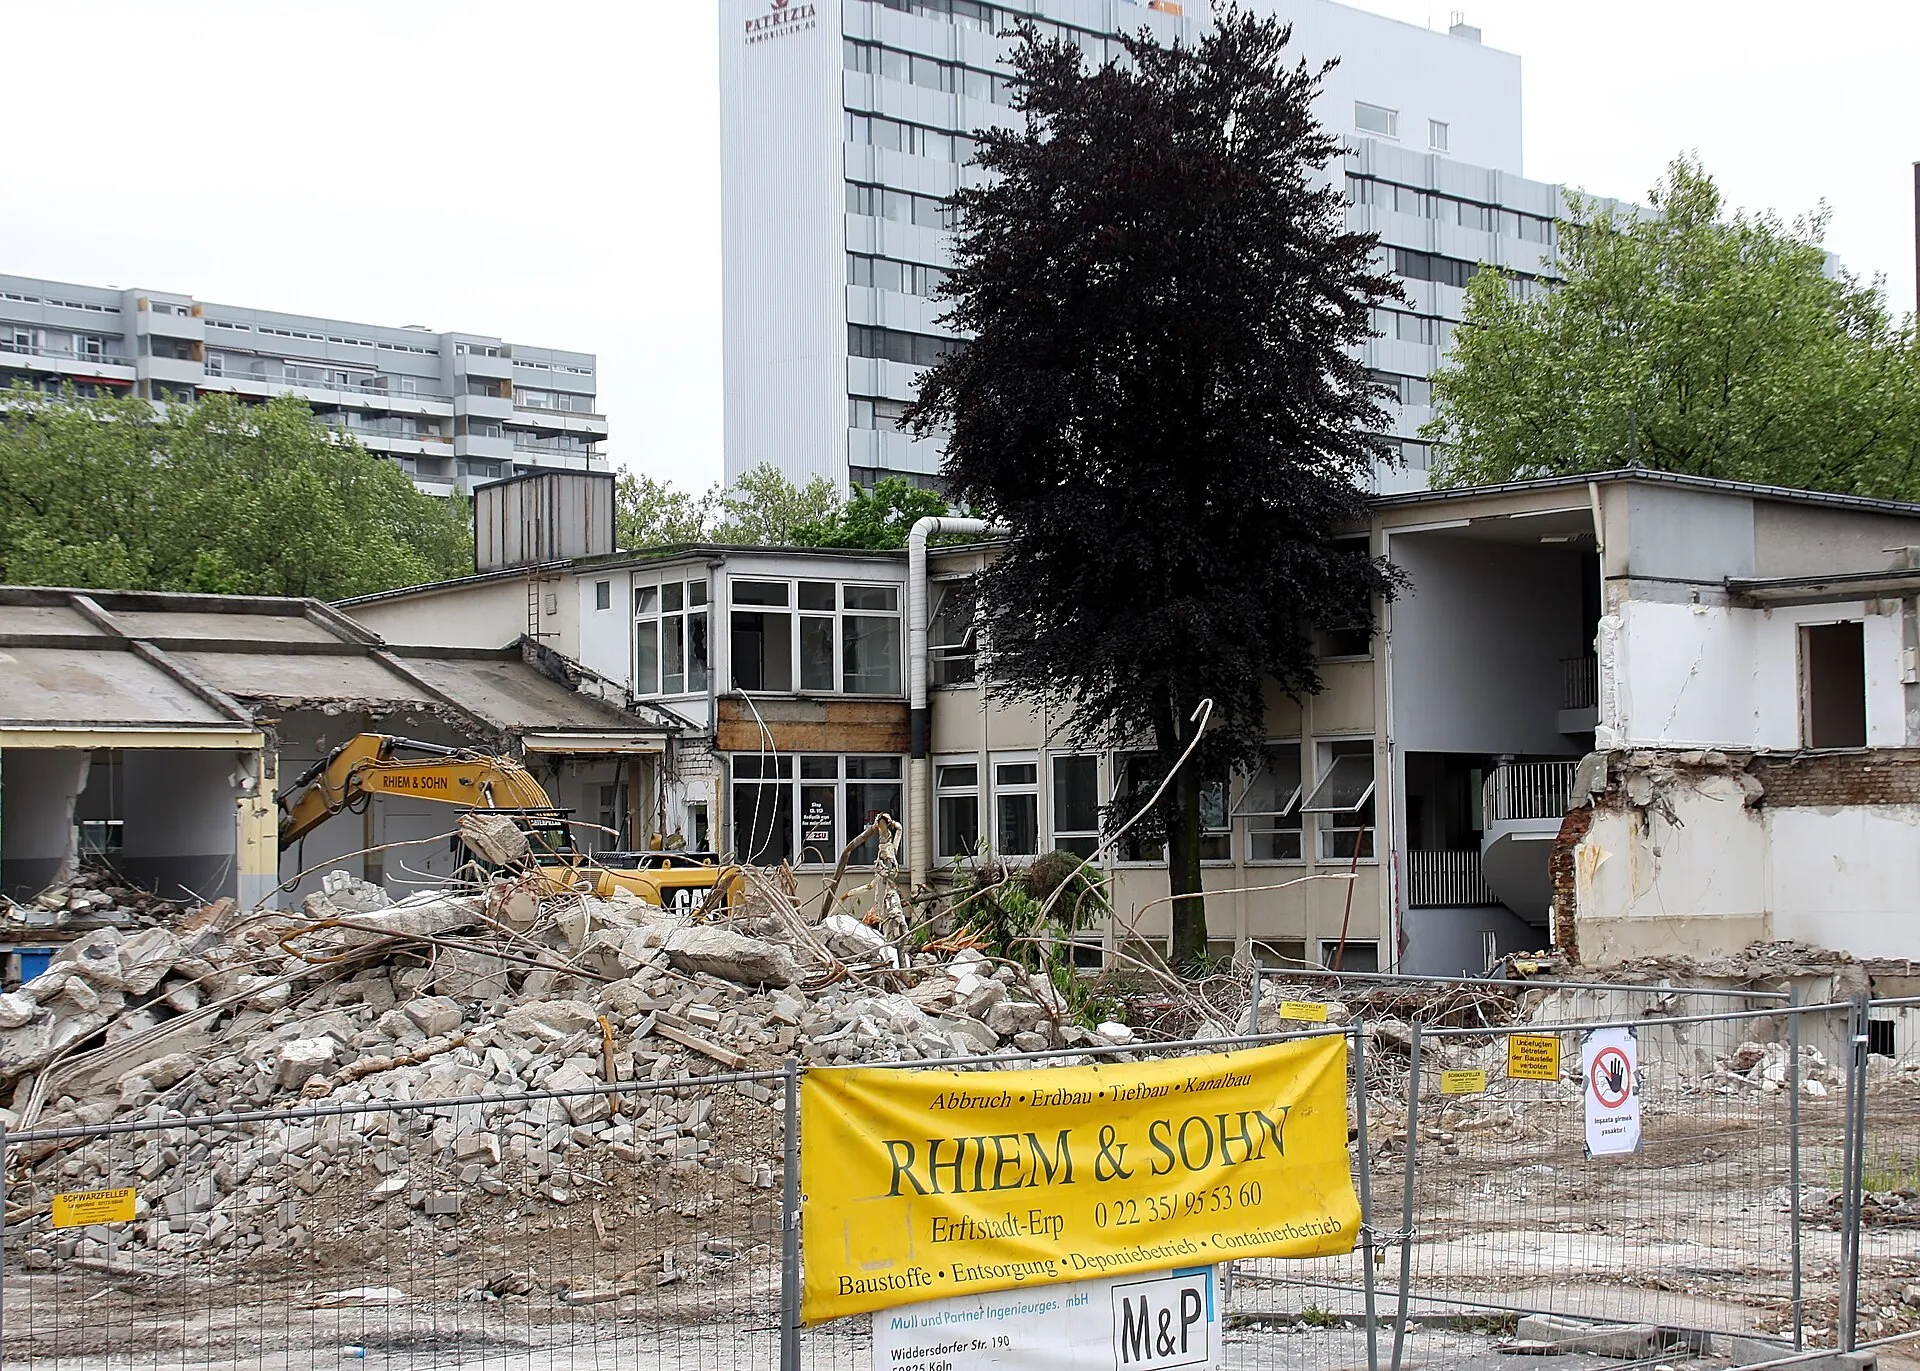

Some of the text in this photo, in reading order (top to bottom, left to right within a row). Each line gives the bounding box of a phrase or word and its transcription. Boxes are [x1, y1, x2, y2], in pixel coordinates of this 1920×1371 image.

[745, 3, 816, 33] PATRIZIA
[745, 20, 816, 45] IMMOBILIEN AG
[383, 775, 448, 789] RHIEM & SOHN
[1516, 1039, 1553, 1049] Unbefugten
[1520, 1046, 1548, 1055] Betreten
[1520, 1062, 1548, 1070] verboten
[1524, 1055, 1554, 1063] Baustelle
[929, 1073, 1252, 1110] Abbruch Erdbau Tiefbau Kanalbau
[1615, 1115, 1632, 1123] girmek
[881, 1105, 1292, 1198] RHIEM & SOHN
[63, 1190, 129, 1203] SCHWARZFELLER
[931, 1208, 1064, 1243] Erftstadt-Erp
[1095, 1202, 1107, 1228] 0
[1113, 1199, 1140, 1226] 22
[1148, 1193, 1178, 1223] 35/
[1239, 1181, 1262, 1207] 60
[838, 1216, 1342, 1296] Baustoffe Entsorgung Deponiebetrieb Containerbetrieb
[890, 1293, 1089, 1331] Mull und Partner Ingenieurges. mbH
[1121, 1288, 1202, 1364] M&P
[890, 1335, 1010, 1361] Widdersdorfer Str. 190
[929, 1360, 952, 1371] Köln
